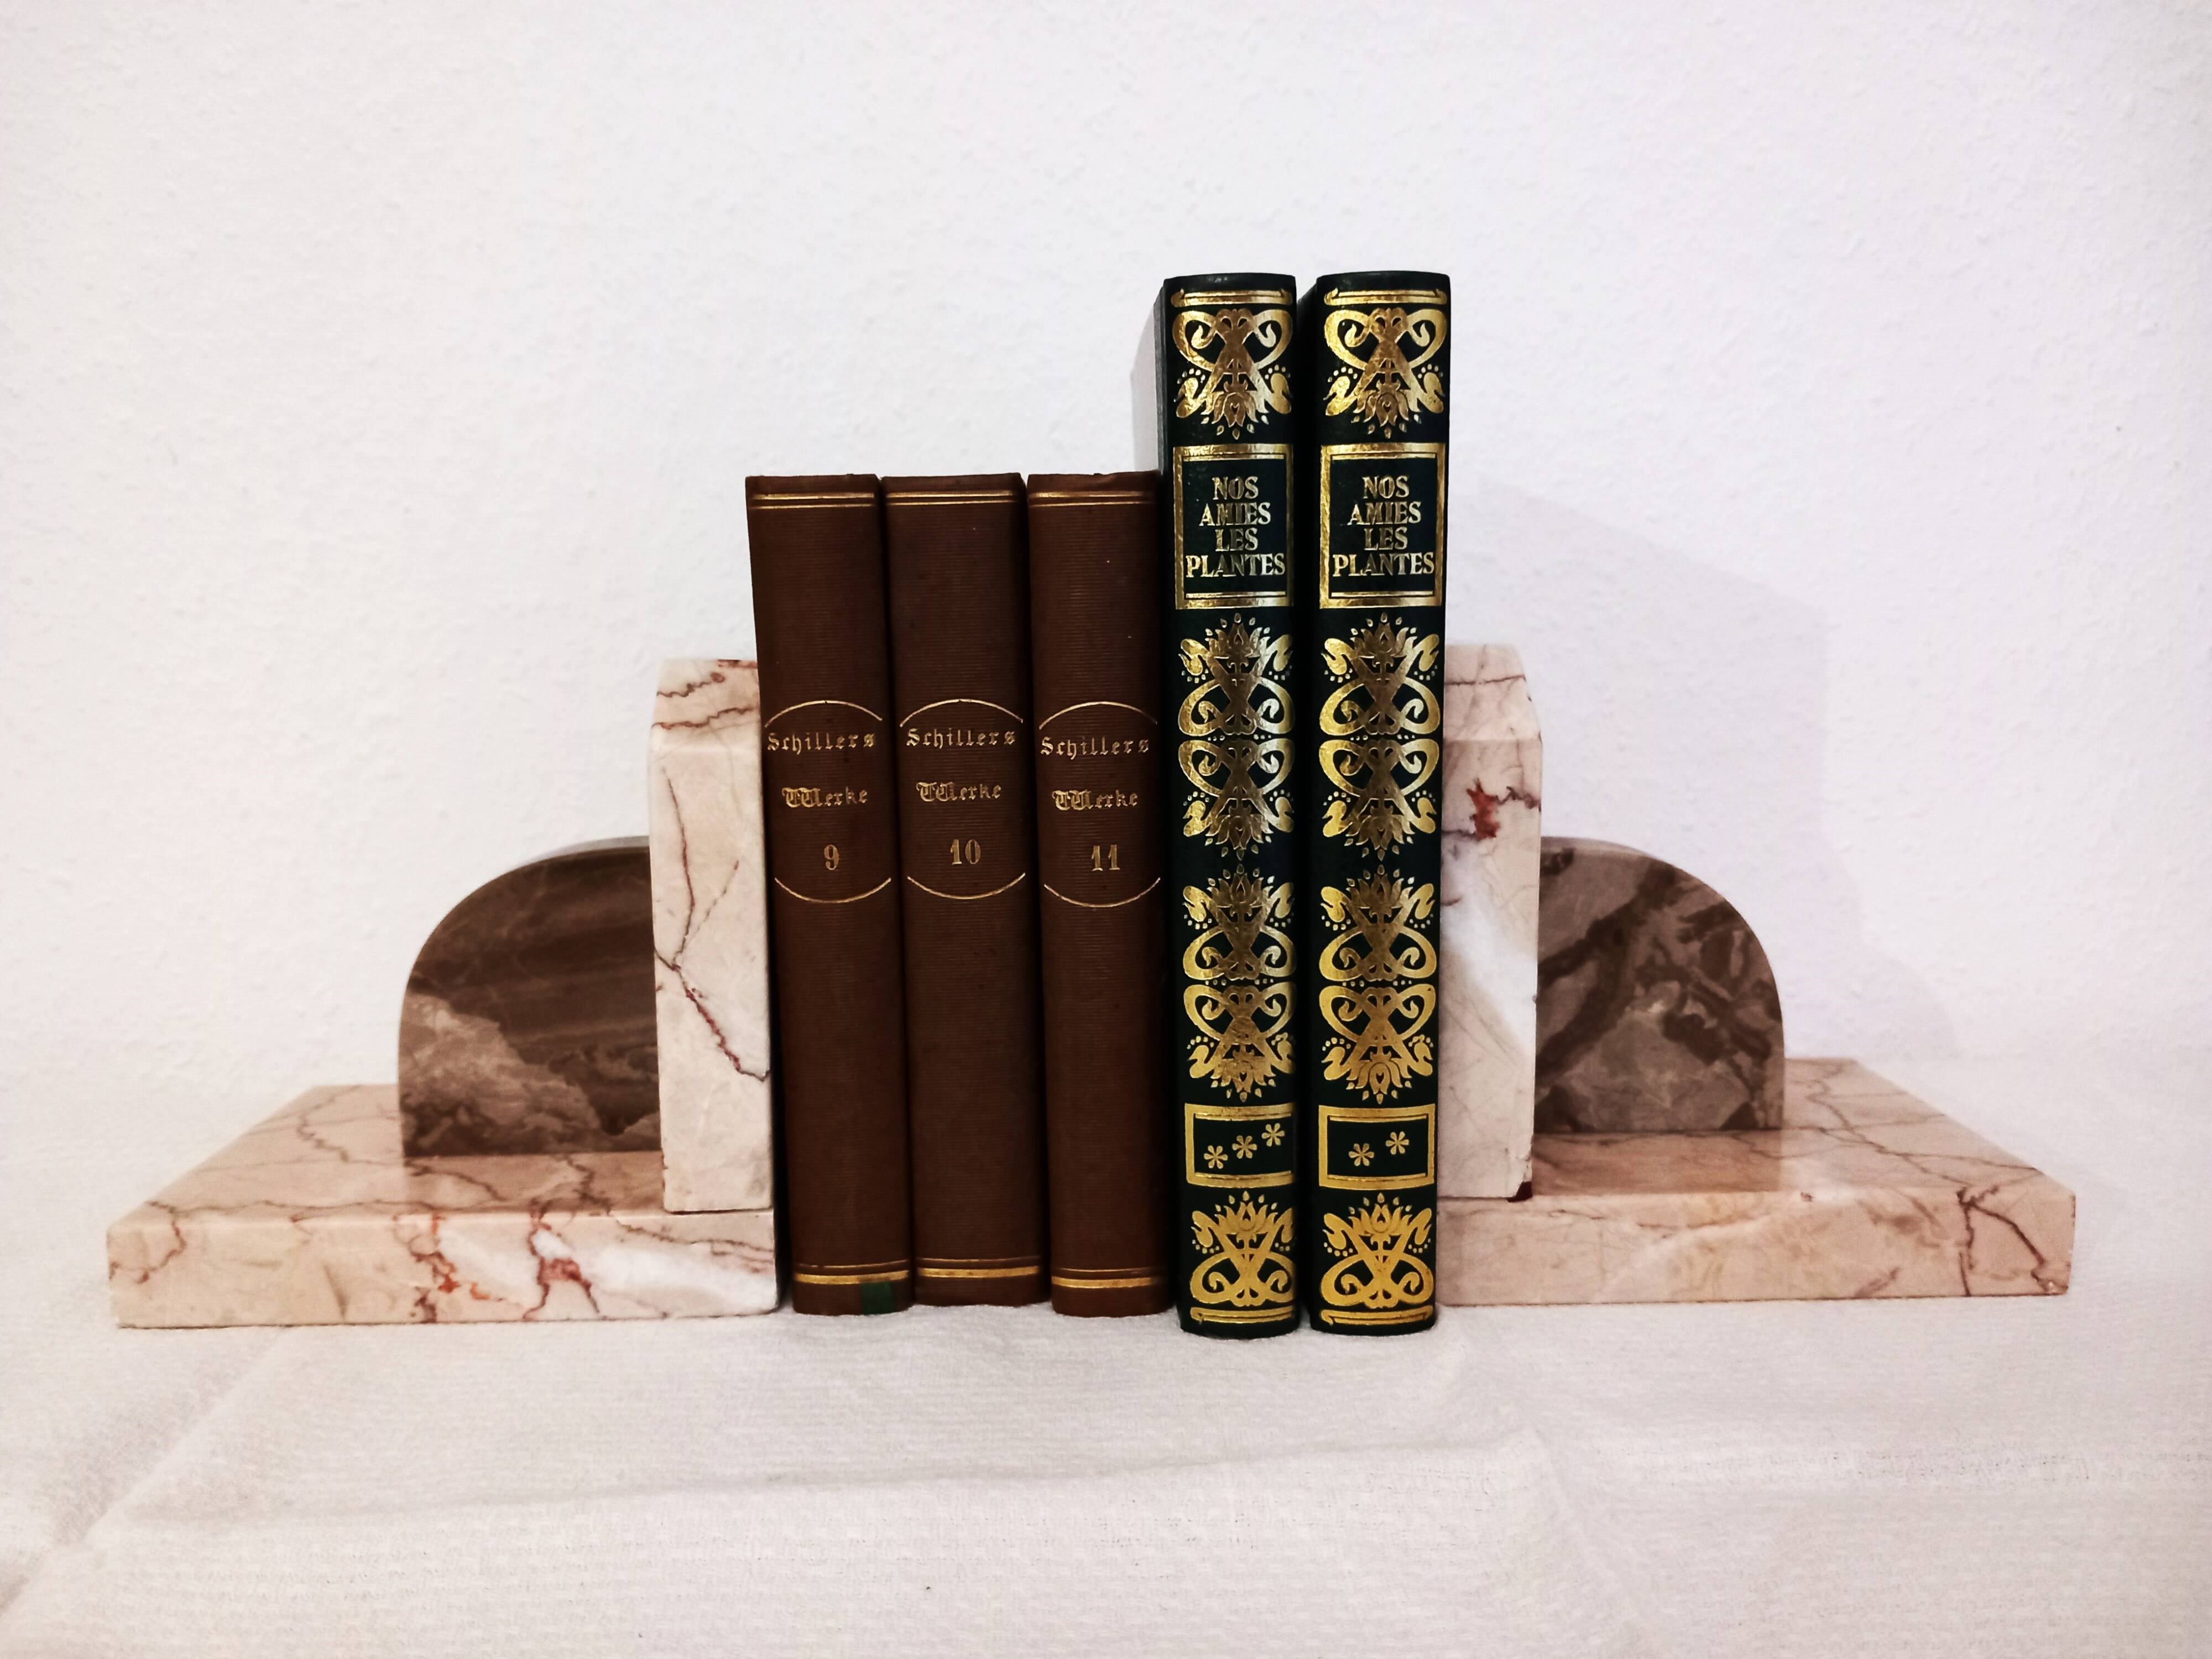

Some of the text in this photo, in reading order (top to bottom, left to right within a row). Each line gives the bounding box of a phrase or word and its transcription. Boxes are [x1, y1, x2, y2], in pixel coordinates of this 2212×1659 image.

[1212, 476, 1259, 500] NOS
[1362, 475, 1409, 499] NOS
[1199, 502, 1271, 526] AMIES
[1347, 501, 1421, 526] AMIES
[1215, 527, 1258, 552] LES
[1364, 526, 1408, 551] LES
[1186, 552, 1285, 578] PLANTES
[1332, 552, 1434, 577] PLANTES
[767, 732, 876, 754] Schillers
[906, 728, 1016, 749] Schillers
[1040, 736, 1150, 759] Schillers
[781, 786, 868, 808] Werke
[916, 781, 1001, 802] Werke
[1052, 790, 1138, 811] Werke
[823, 844, 840, 870] 9
[950, 839, 981, 865] 10
[1091, 844, 1121, 872] 11
